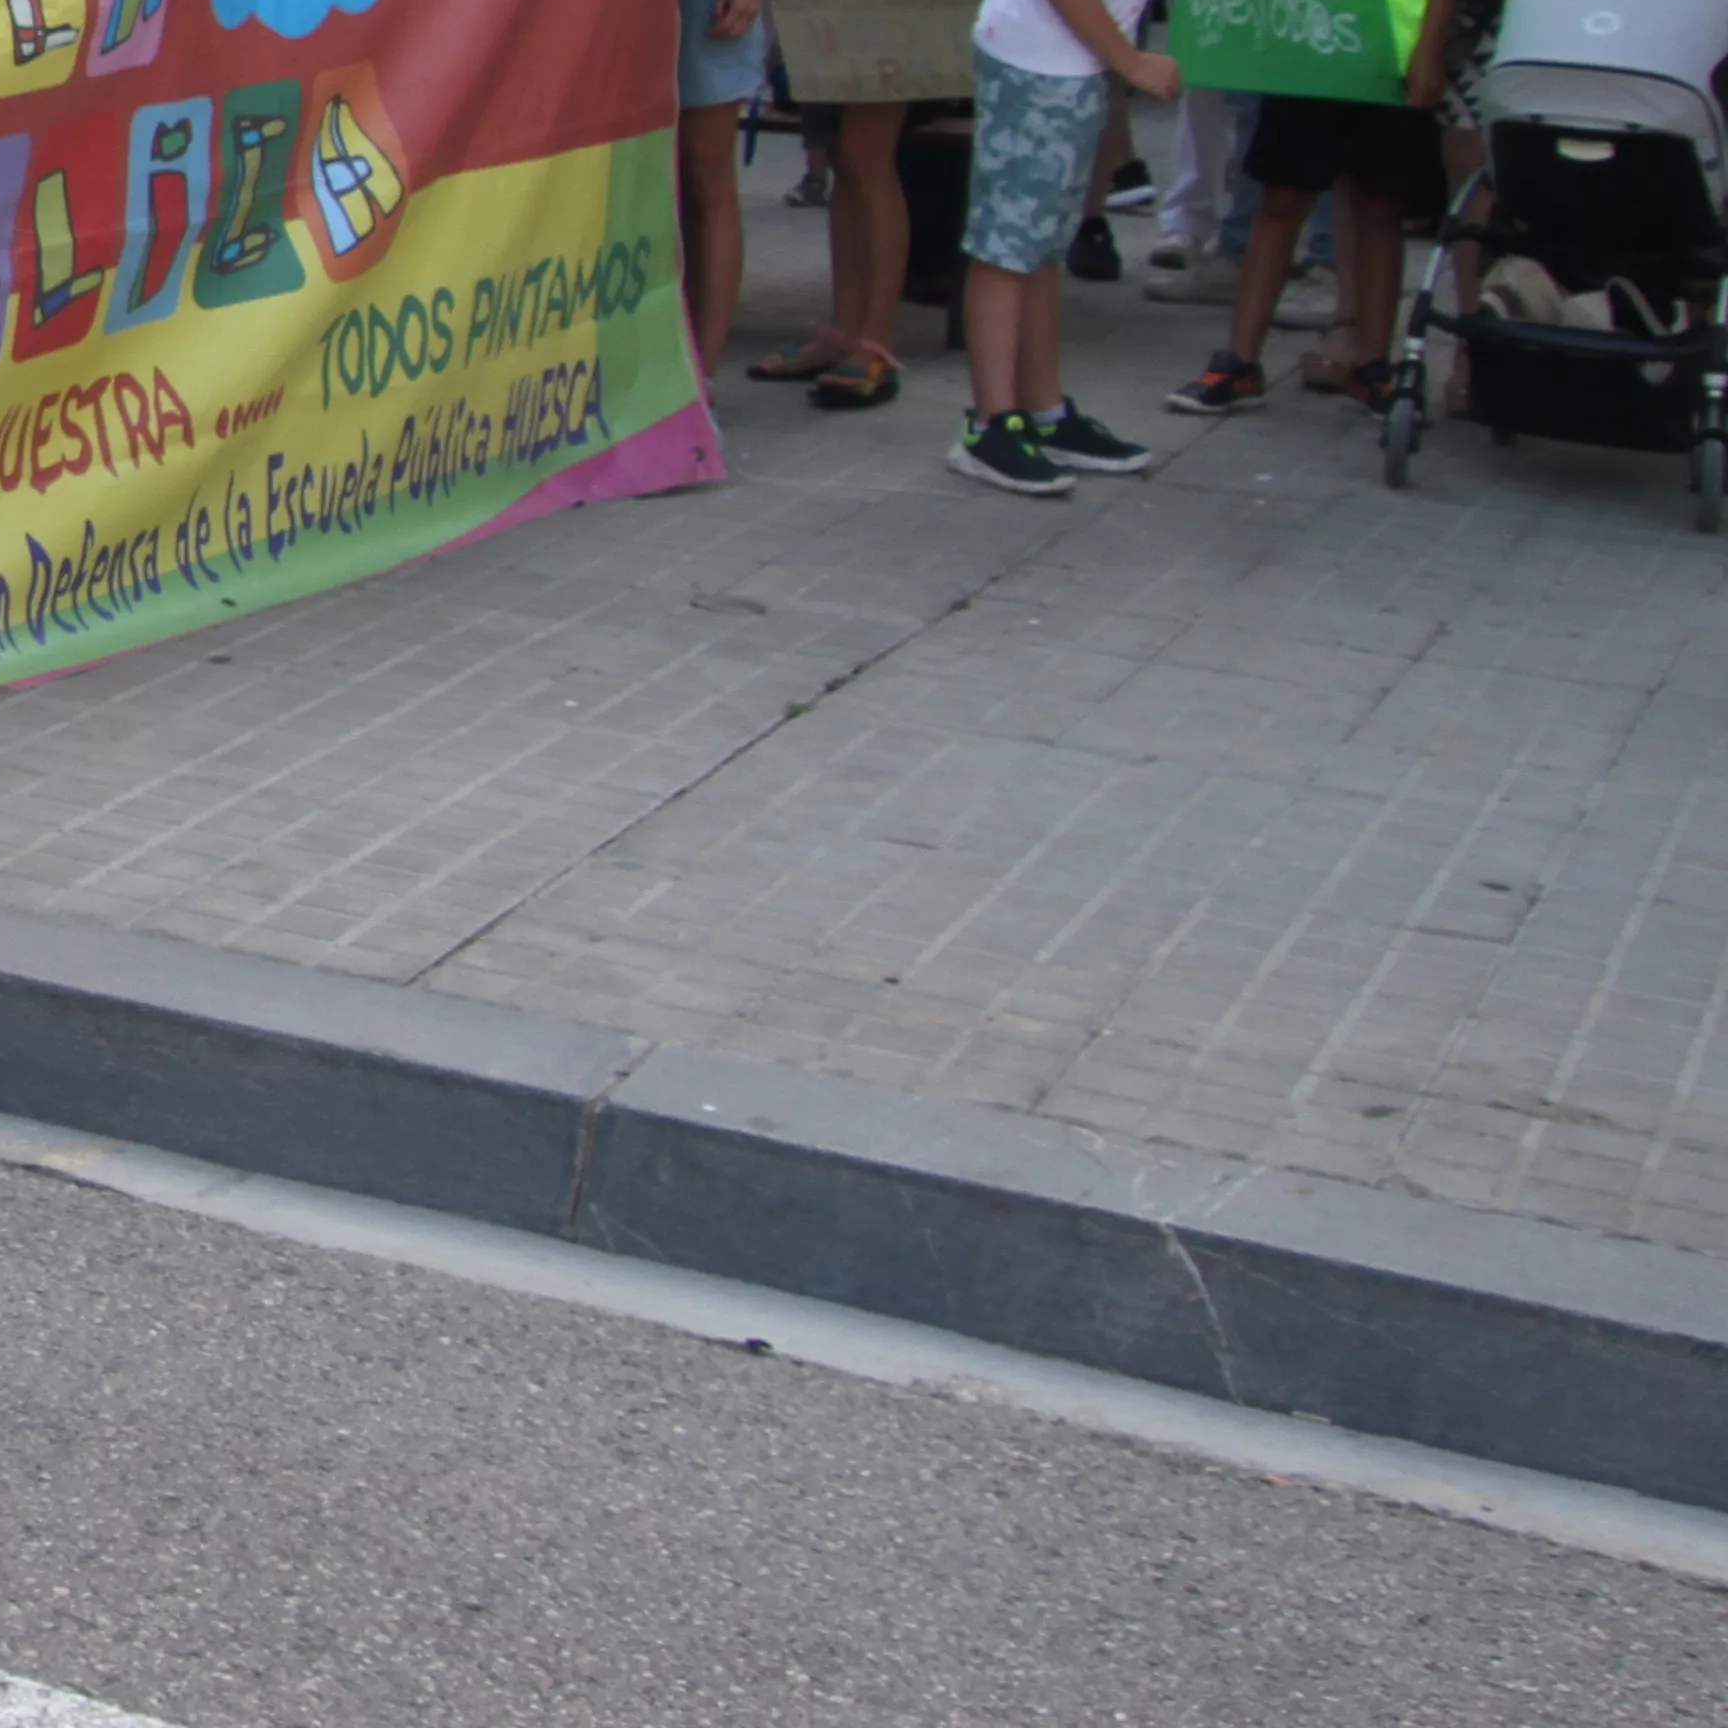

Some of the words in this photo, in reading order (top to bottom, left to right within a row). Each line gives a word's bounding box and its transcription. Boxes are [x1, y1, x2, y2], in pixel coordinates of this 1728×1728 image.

[320, 285, 456, 412] TODOS
[464, 234, 651, 369] PINTAMOS
[25, 518, 162, 647] Defensa
[175, 486, 221, 591] de
[224, 468, 254, 572] la
[267, 428, 384, 564] Escuela
[389, 397, 492, 515] Pública
[498, 354, 612, 469] HUESCA
